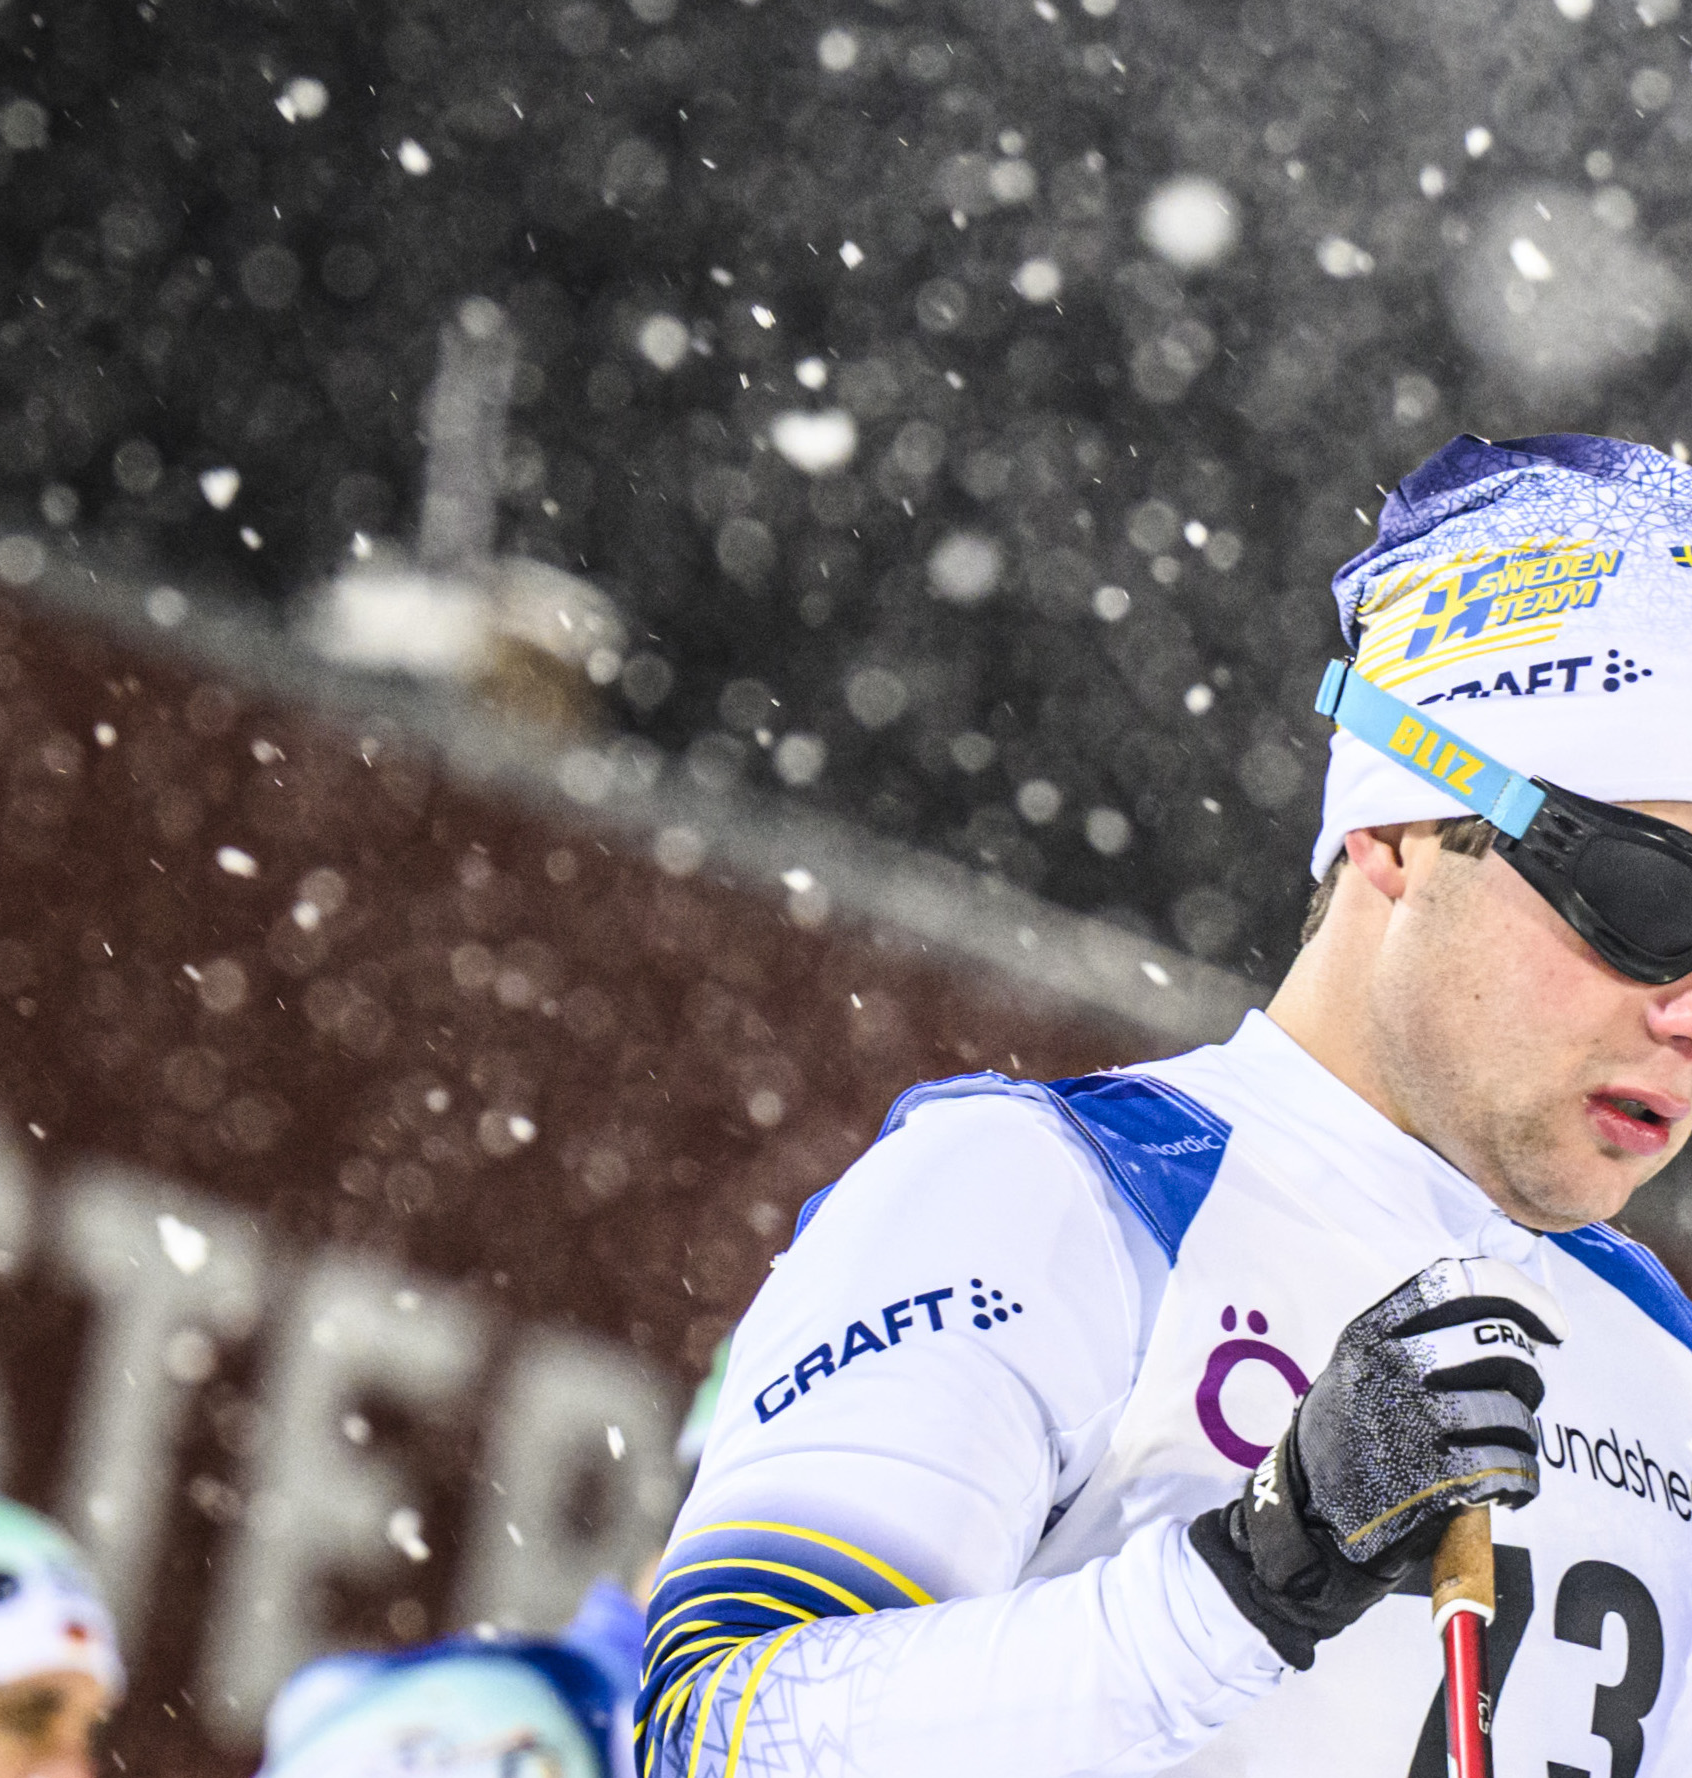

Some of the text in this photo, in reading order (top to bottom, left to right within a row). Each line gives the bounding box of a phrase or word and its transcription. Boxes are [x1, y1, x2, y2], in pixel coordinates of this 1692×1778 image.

[1458, 549, 1624, 602] SWEDEN
[1495, 579, 1603, 626] TEAM
[1388, 714, 1486, 796] BLIZ
[753, 1287, 954, 1424] CRAFT
